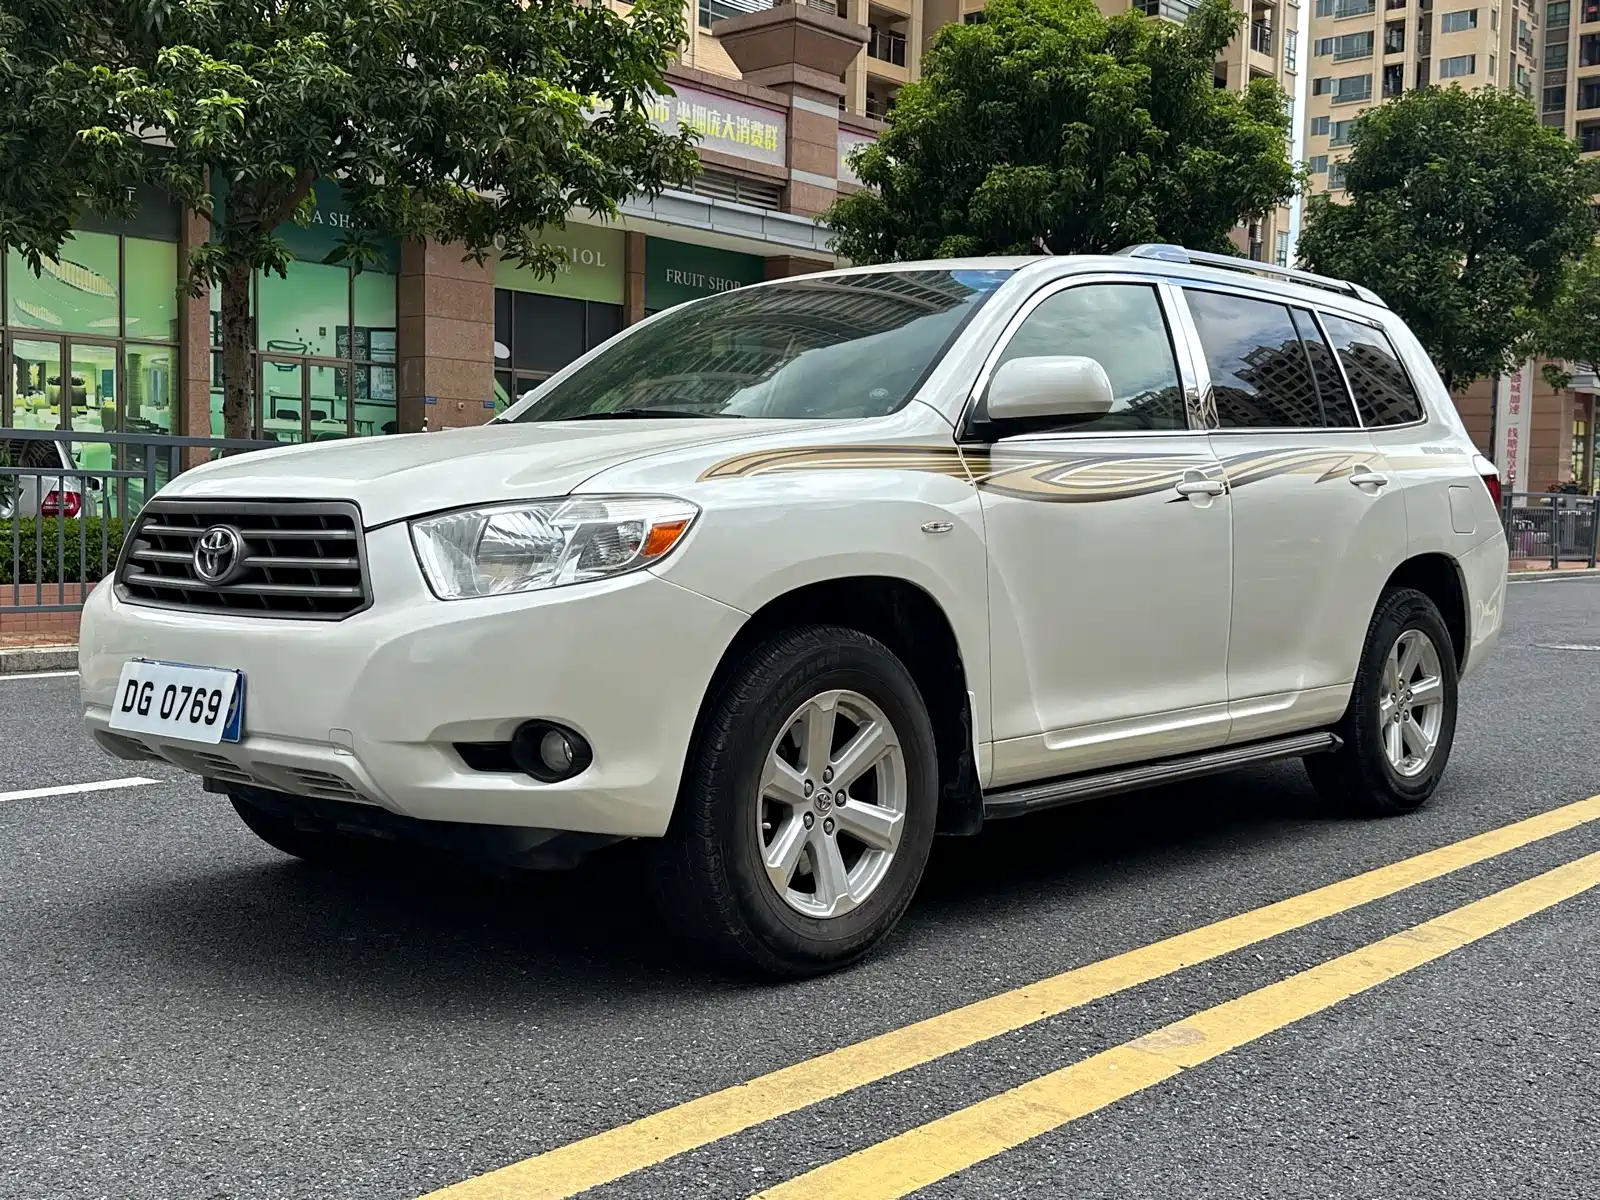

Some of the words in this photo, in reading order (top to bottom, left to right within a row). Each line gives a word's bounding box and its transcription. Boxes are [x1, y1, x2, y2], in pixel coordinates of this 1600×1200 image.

[666, 268, 705, 288] FRUIT
[121, 679, 154, 716] DG
[160, 684, 222, 726] 0769
